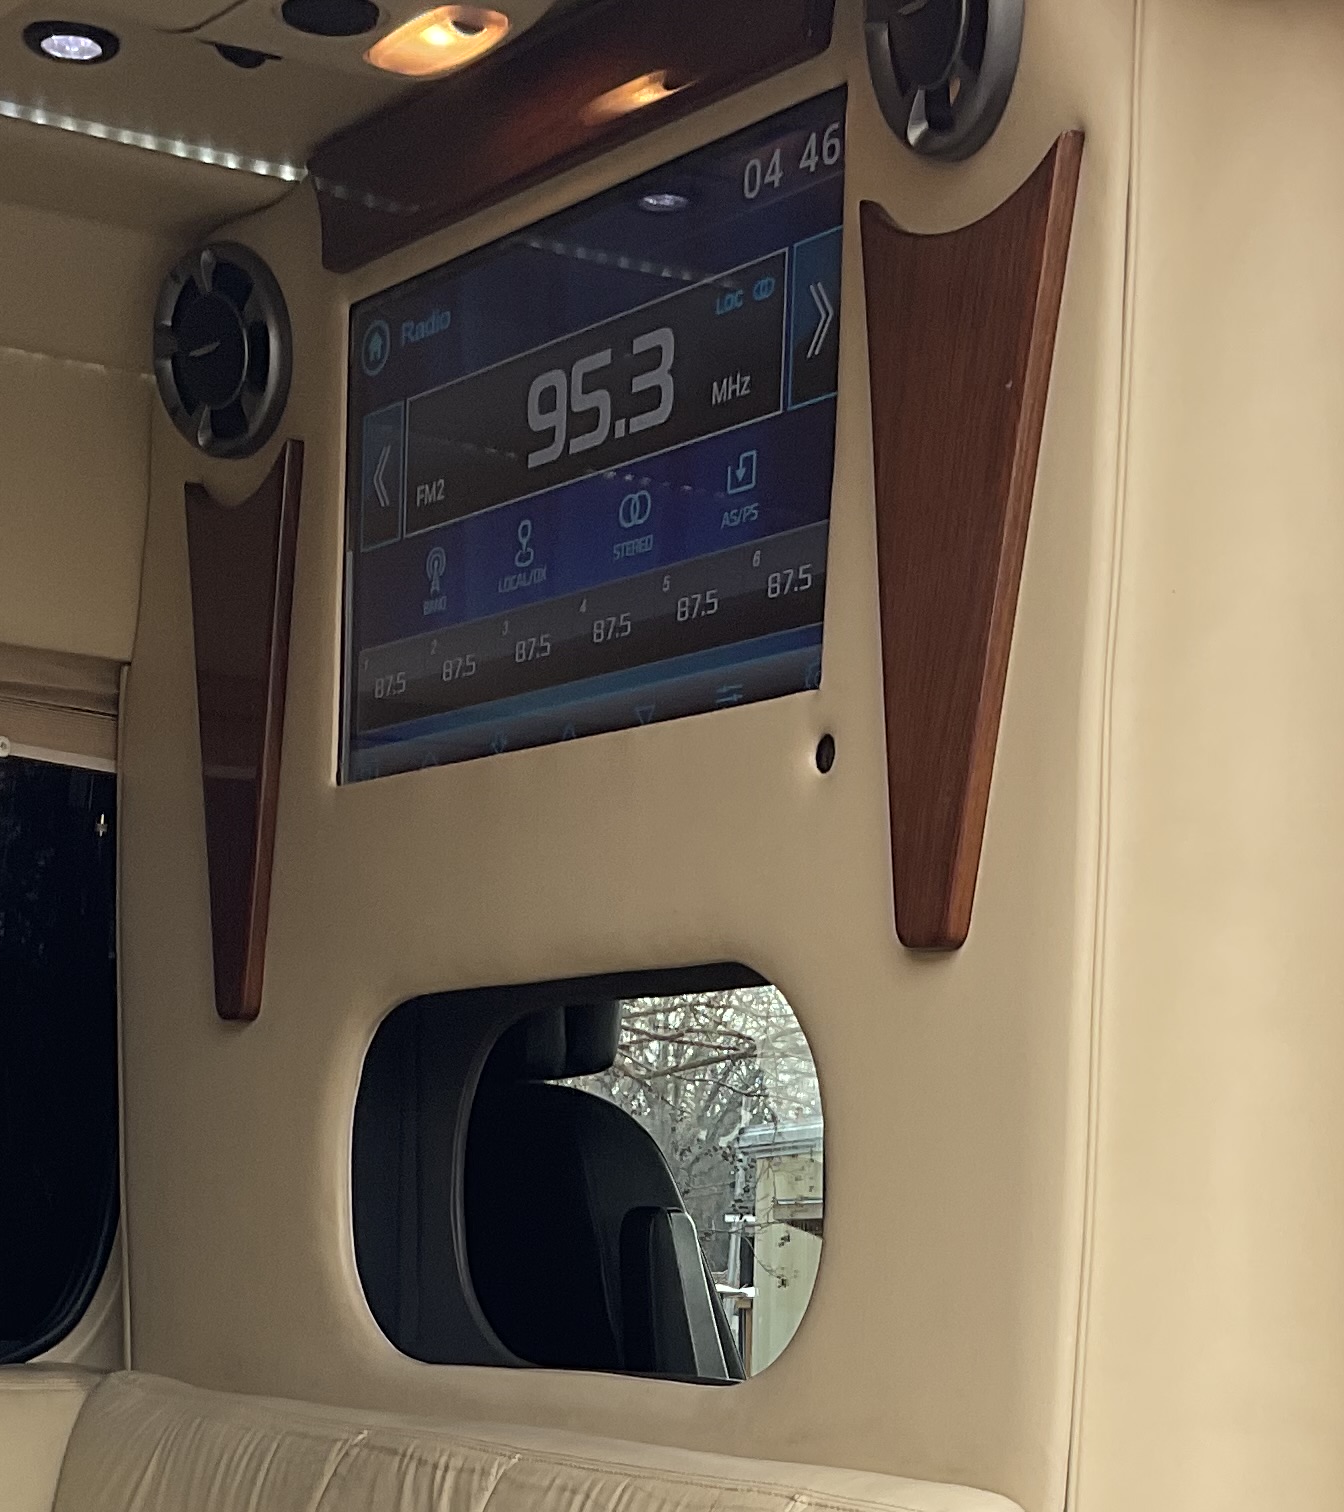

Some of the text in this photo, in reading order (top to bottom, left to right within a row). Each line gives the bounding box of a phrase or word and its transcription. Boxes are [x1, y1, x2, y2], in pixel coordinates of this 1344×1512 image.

[743, 121, 841, 199] 04 46
[403, 310, 451, 344] Radio
[527, 327, 674, 469] 95.3
[712, 370, 751, 406] MHz
[416, 478, 445, 507] FM2
[721, 503, 759, 528] AS/PS
[613, 534, 653, 560] STEREO
[752, 550, 762, 568] 6
[662, 575, 671, 593] 5
[767, 564, 813, 599] 87.5
[579, 599, 587, 614] 4
[676, 589, 720, 622] 87.5
[502, 620, 509, 637] 3
[592, 612, 632, 644] 87.5
[430, 639, 438, 656] 2
[515, 634, 552, 663] 87.5
[442, 653, 476, 682] 87.5
[375, 672, 406, 698] 87.5
